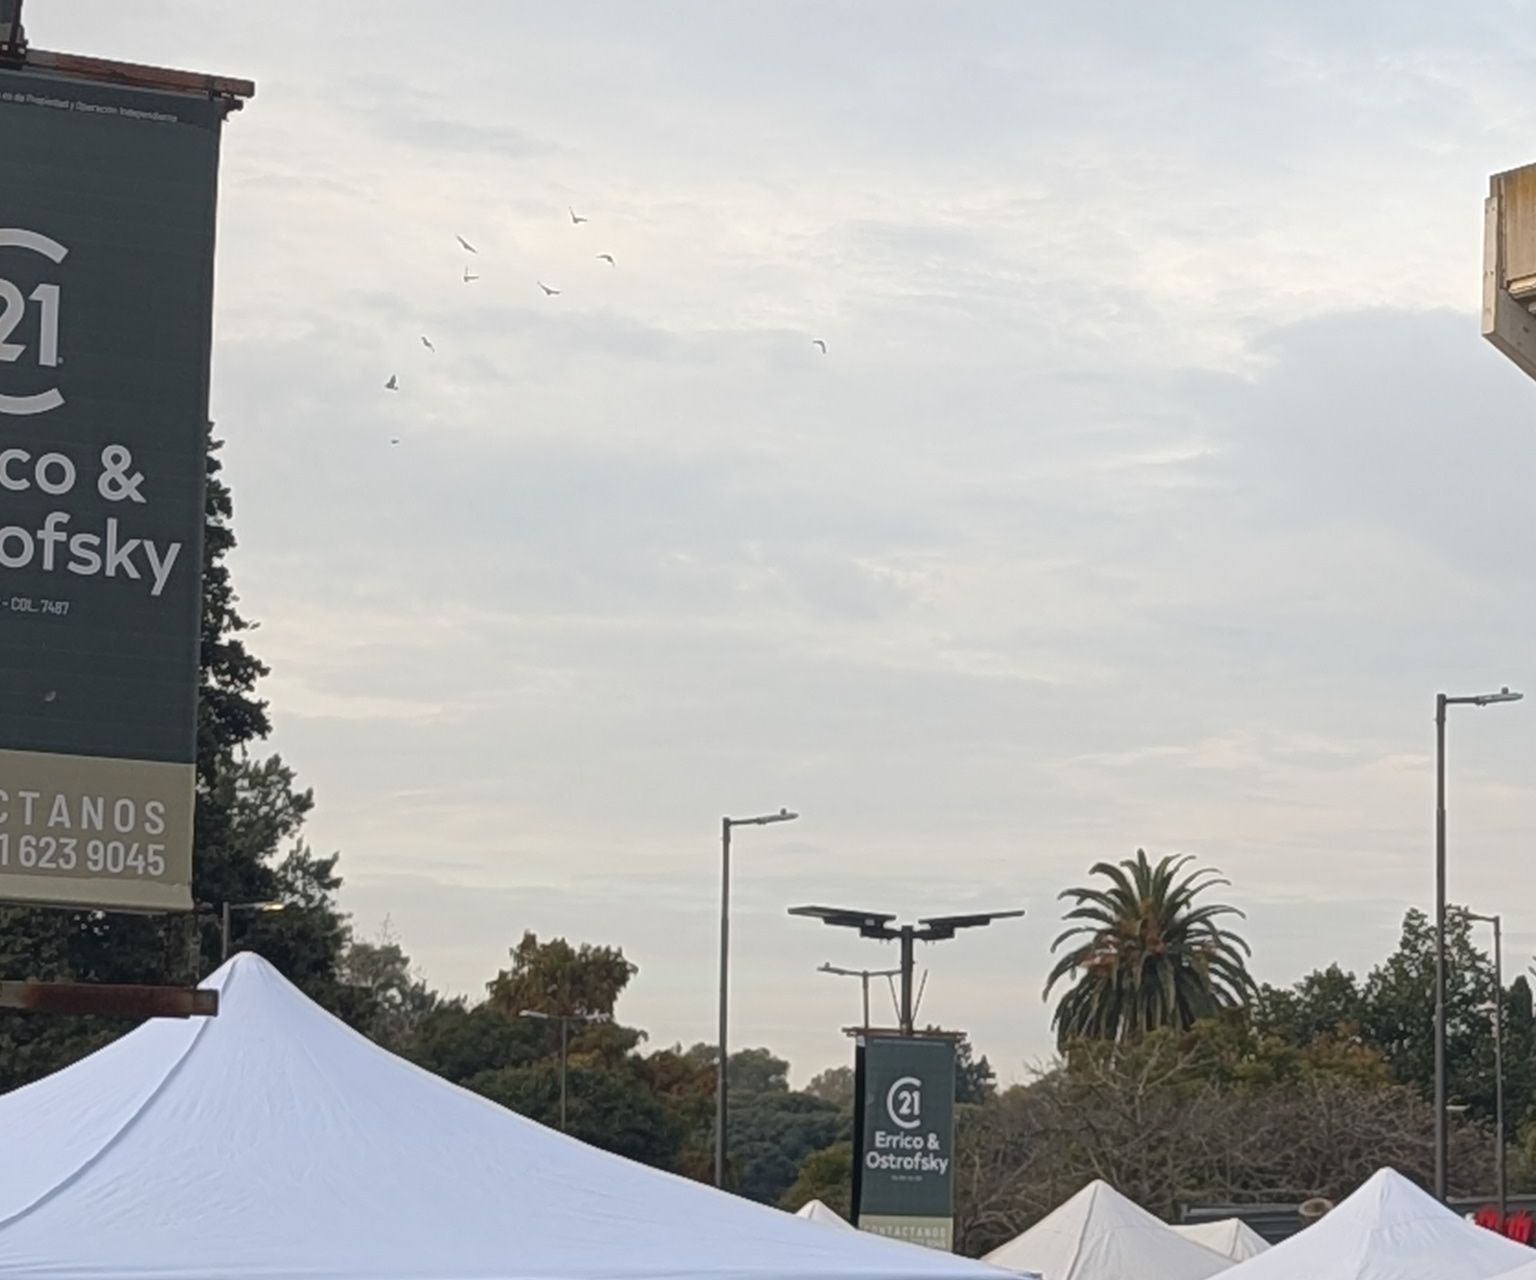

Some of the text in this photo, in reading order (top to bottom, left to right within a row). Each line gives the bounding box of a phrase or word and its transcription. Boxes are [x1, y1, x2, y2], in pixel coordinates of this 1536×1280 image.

[97, 444, 147, 503] &
[19, 835, 77, 870] 623
[87, 839, 165, 875] 9045
[874, 1131, 940, 1150] Errico &
[865, 1151, 949, 1175] Ostrofsky
